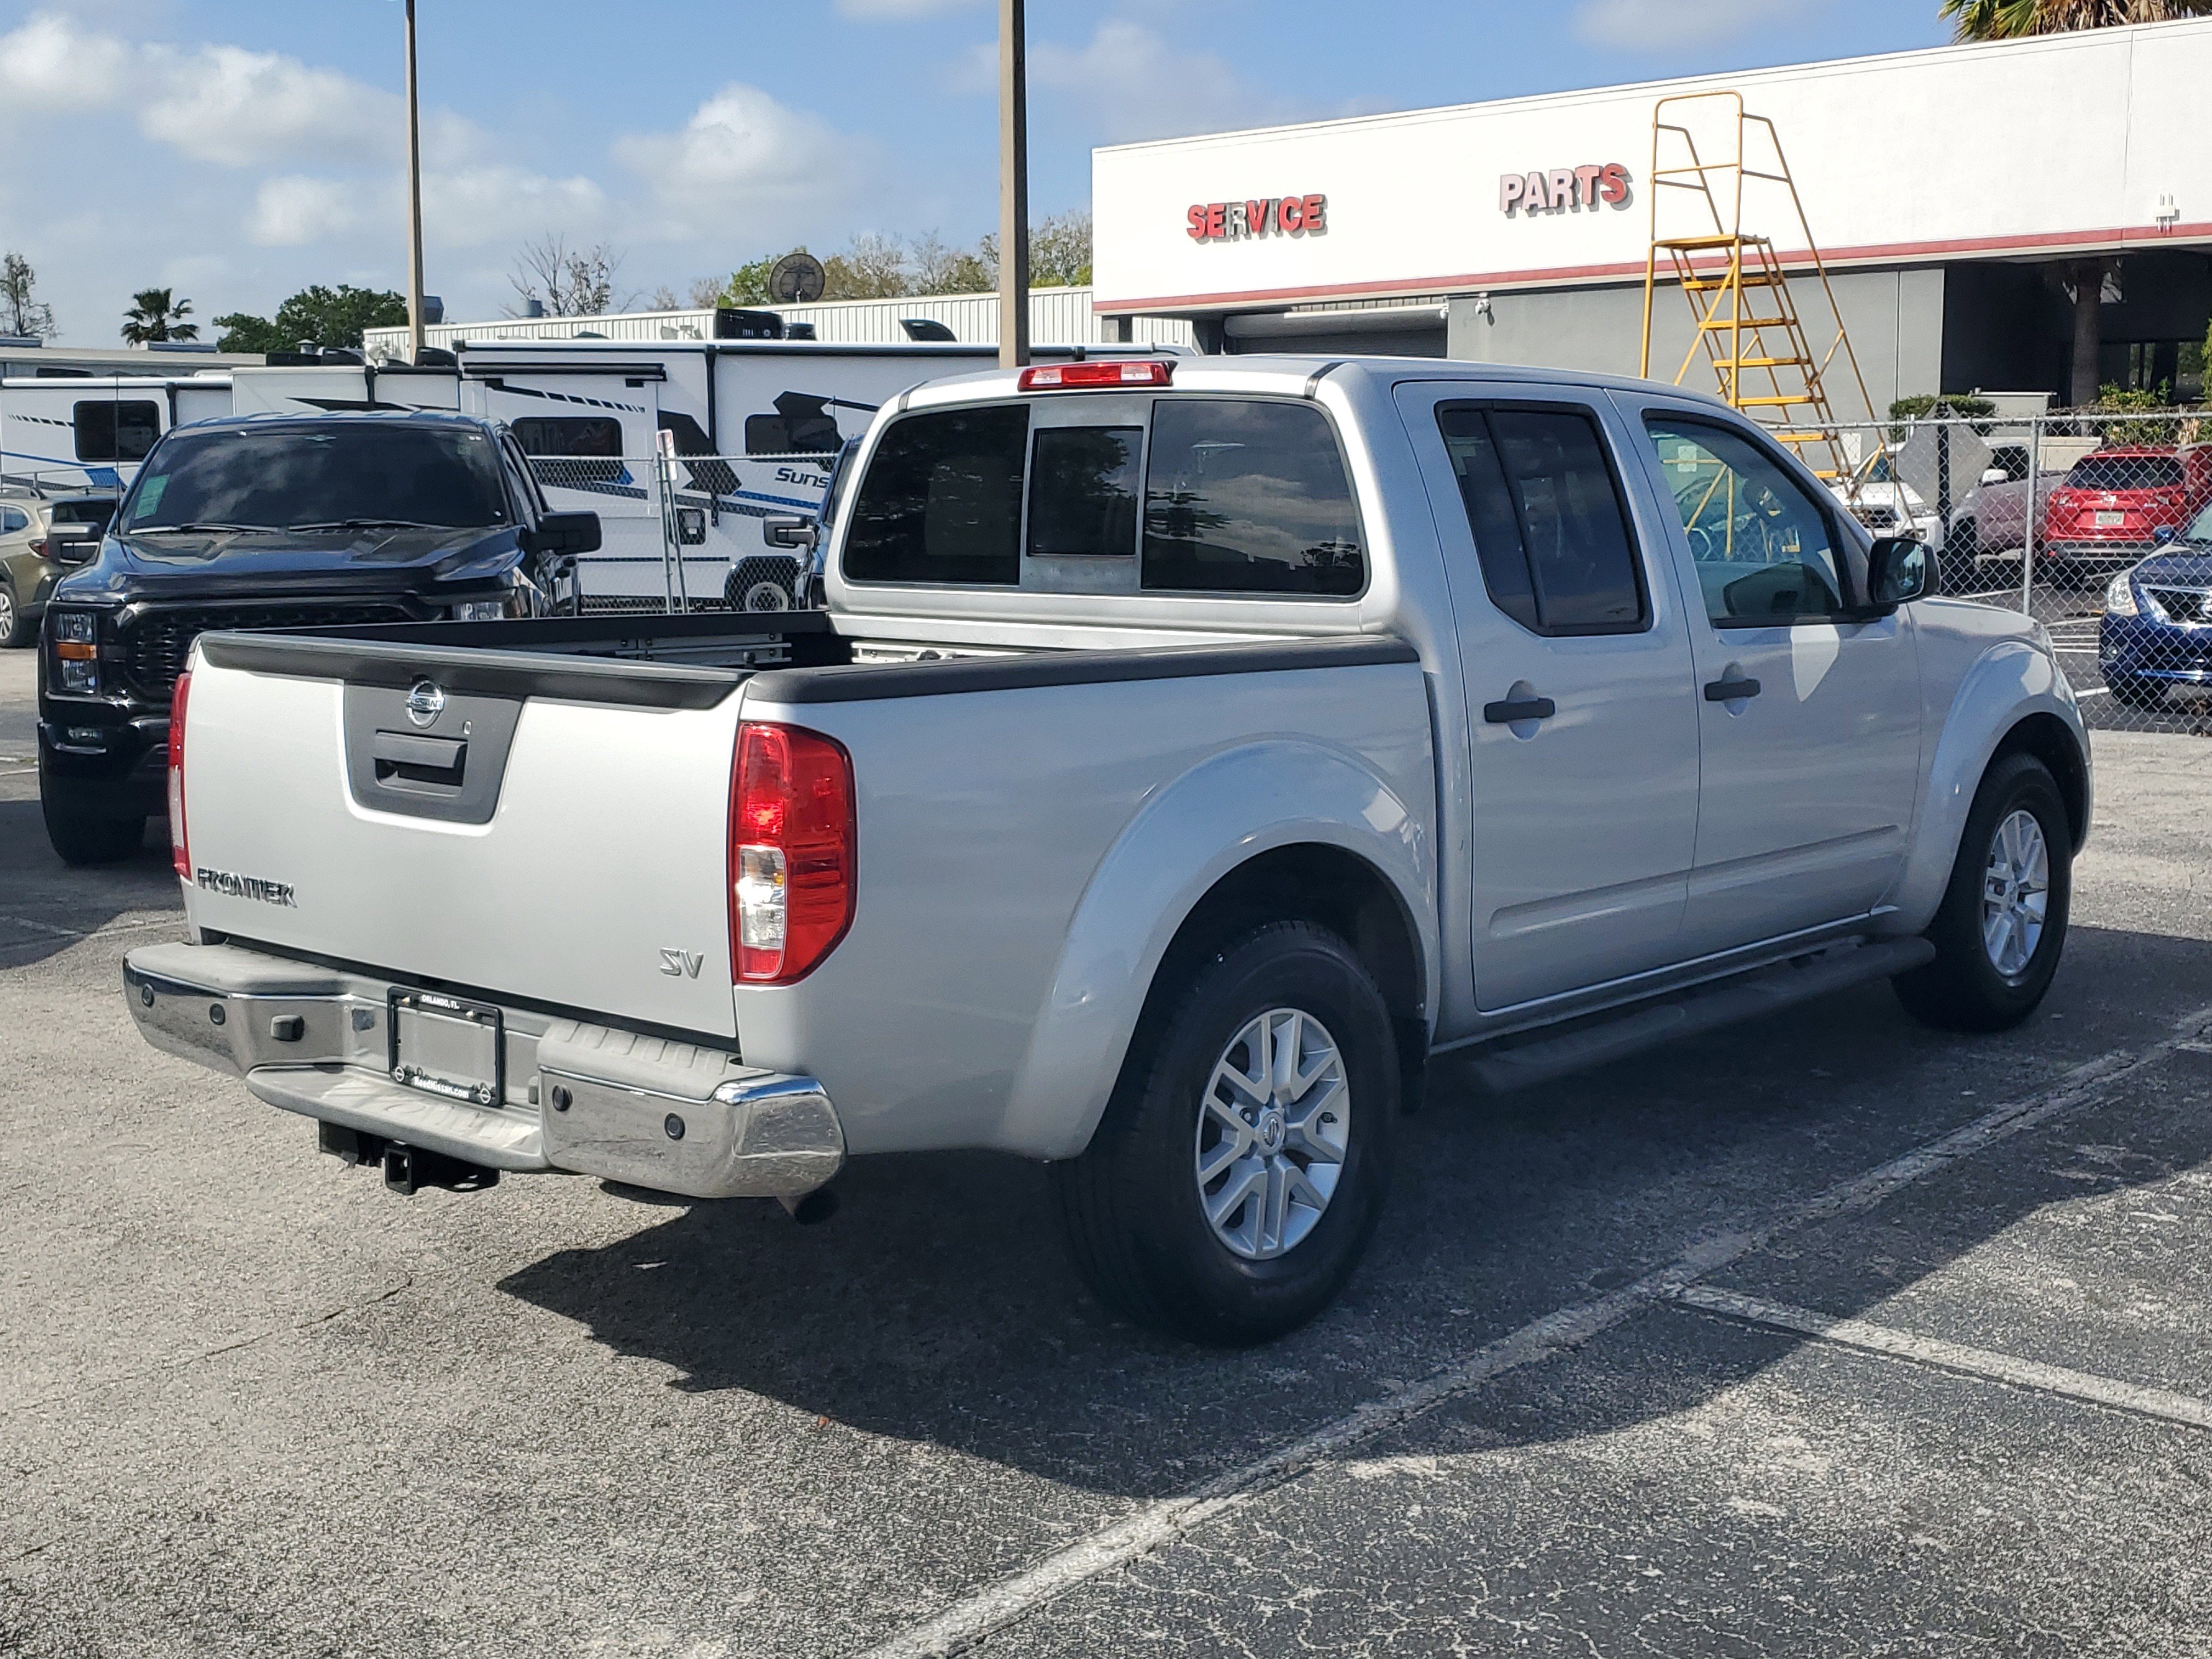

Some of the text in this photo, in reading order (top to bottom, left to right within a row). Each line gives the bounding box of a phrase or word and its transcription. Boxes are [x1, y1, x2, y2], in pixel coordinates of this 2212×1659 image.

[1499, 163, 1628, 212] PARTS
[1187, 194, 1325, 240] SERVICE
[198, 867, 298, 908] FRONTIER
[660, 947, 704, 979] SV
